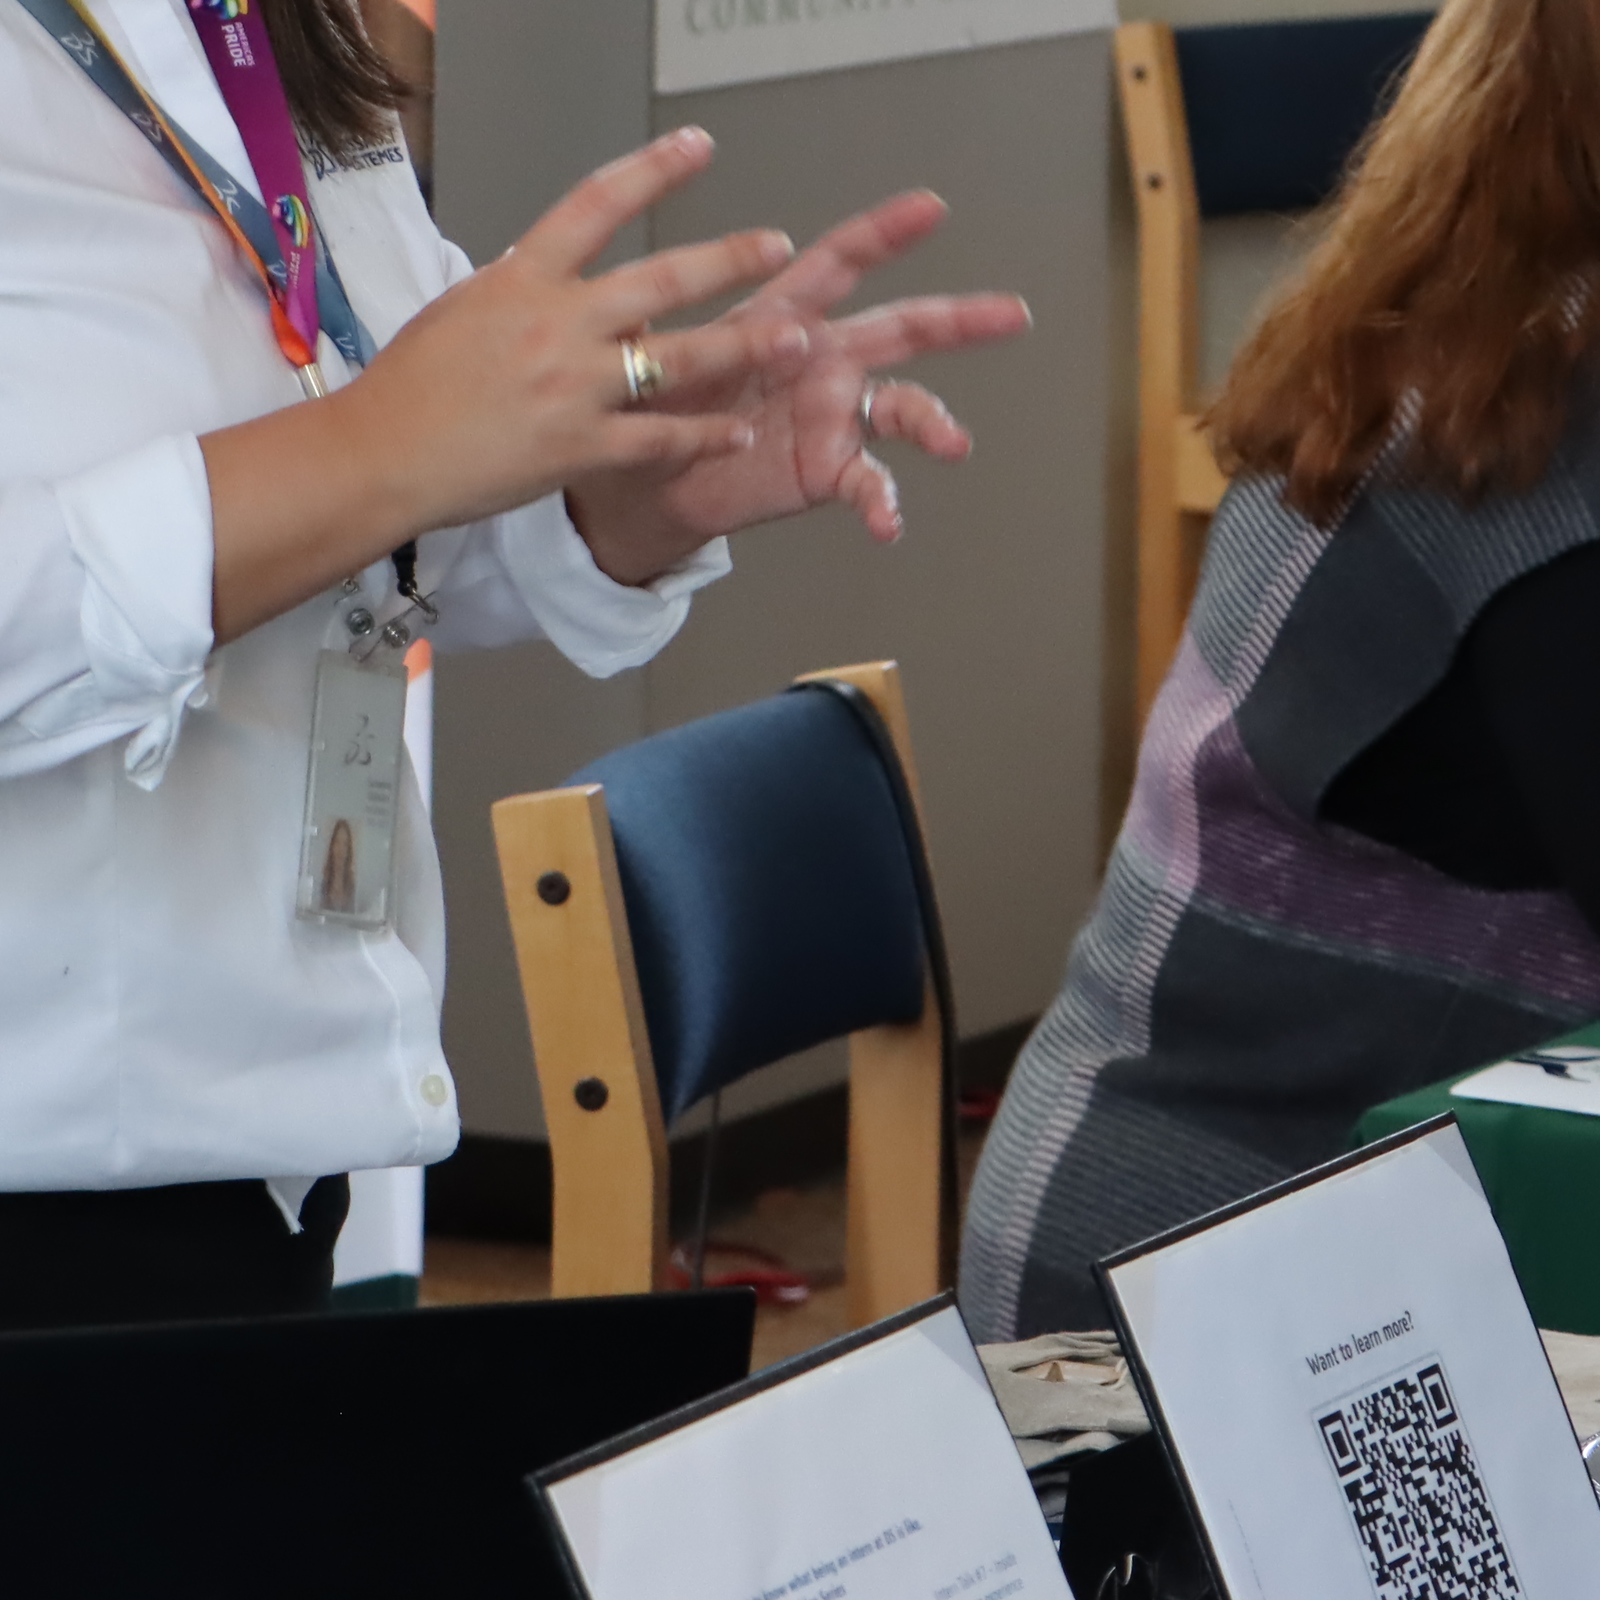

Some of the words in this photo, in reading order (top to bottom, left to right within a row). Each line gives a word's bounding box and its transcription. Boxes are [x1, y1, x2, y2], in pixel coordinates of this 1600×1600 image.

[220, 24, 248, 68] PRIDE
[1305, 1347, 1340, 1376] Want
[1338, 1343, 1354, 1361] to
[1351, 1333, 1383, 1355] learn
[1382, 1310, 1415, 1342] more?
